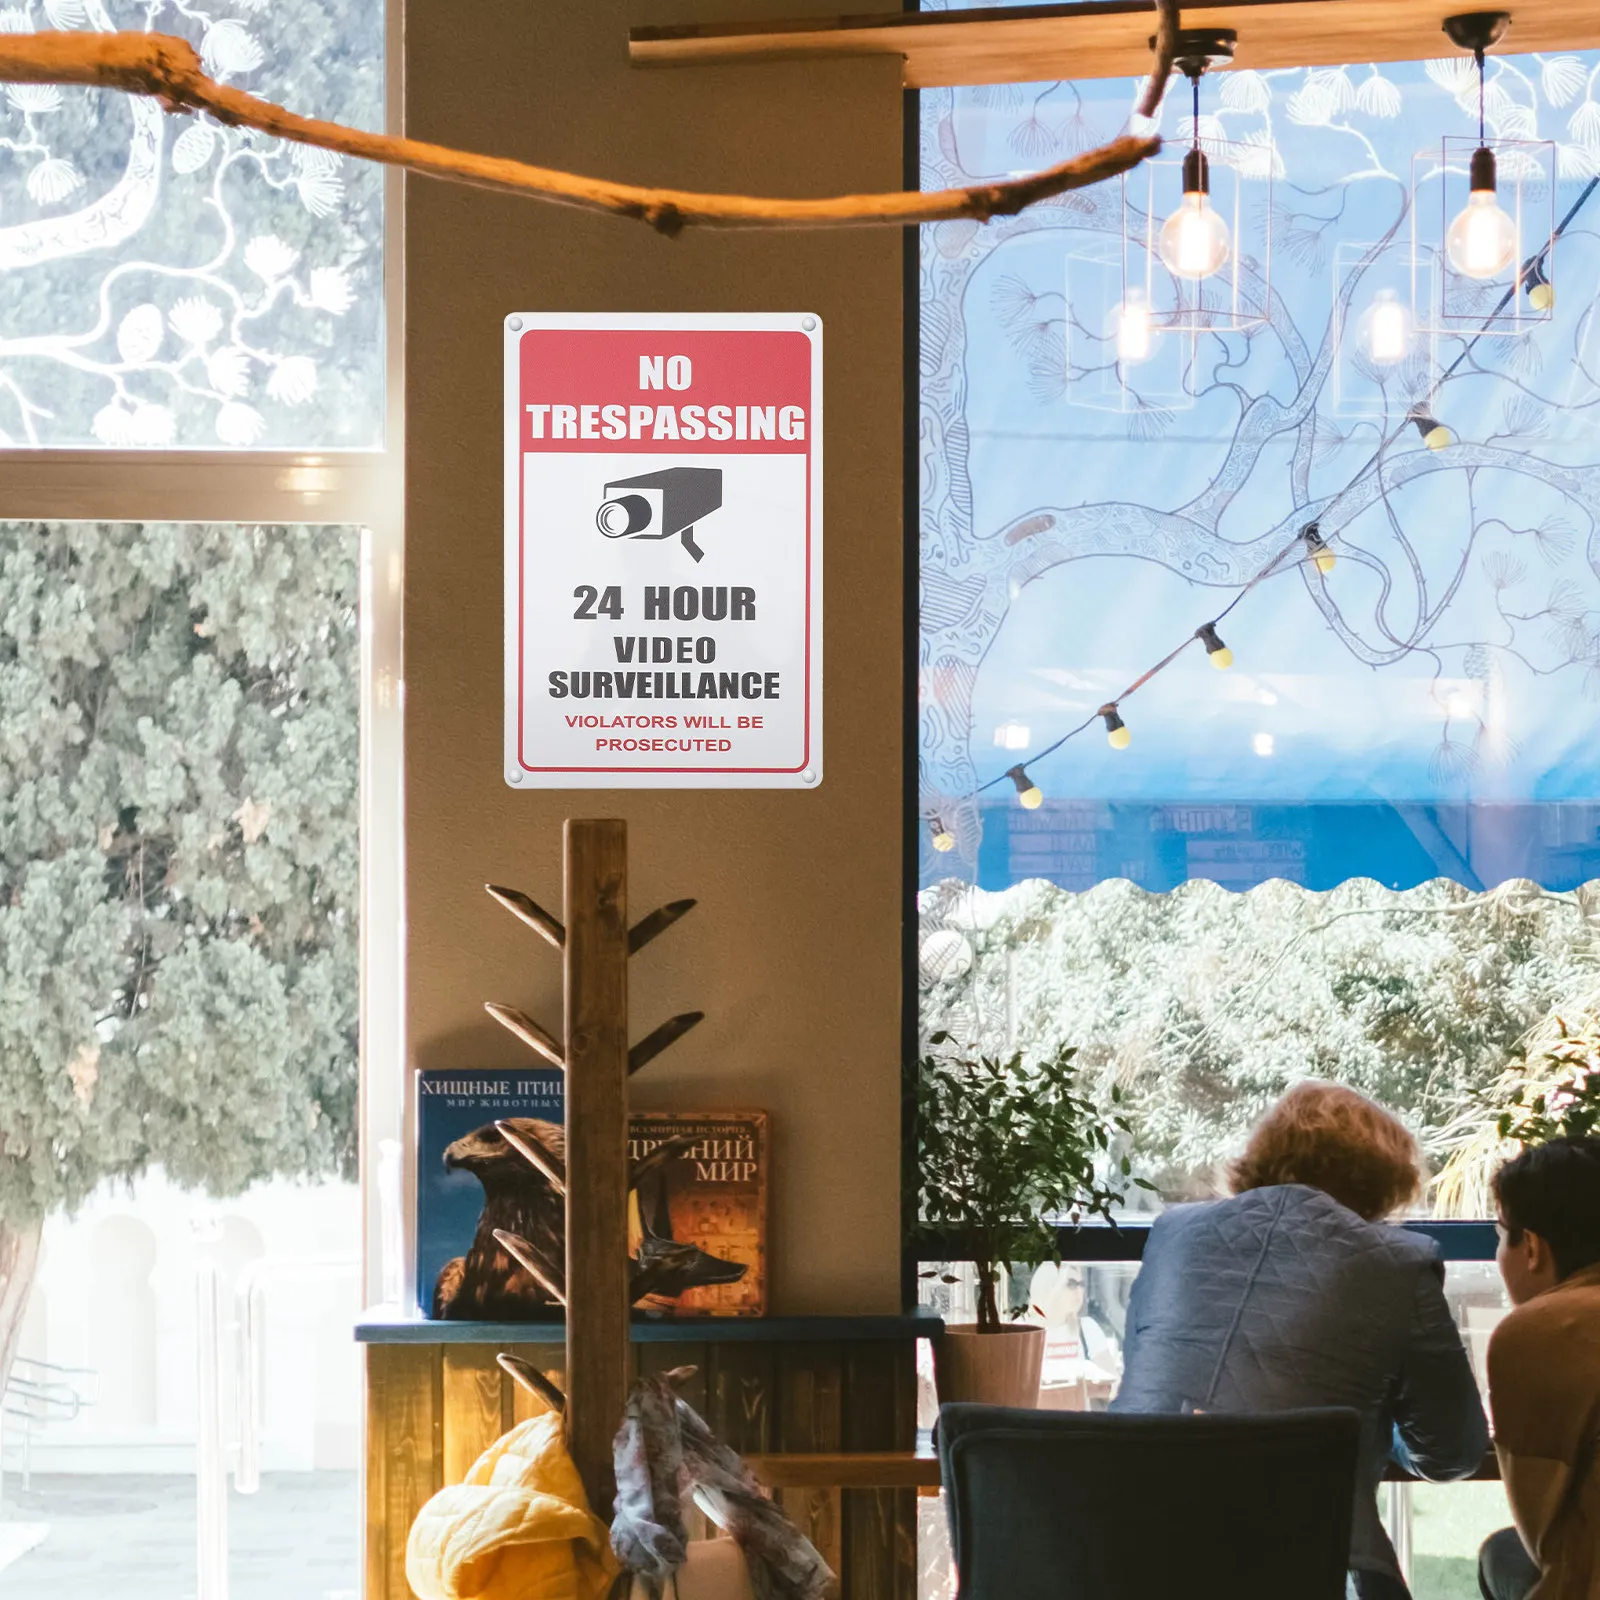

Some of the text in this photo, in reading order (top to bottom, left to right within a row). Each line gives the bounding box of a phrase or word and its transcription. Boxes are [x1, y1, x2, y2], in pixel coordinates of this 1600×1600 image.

[639, 355, 692, 391] NO
[526, 404, 805, 441] TRESPASSING
[573, 585, 756, 621] 24 HOUR
[613, 636, 716, 664] VIDEO
[548, 671, 780, 699] SURVEILLANCE
[564, 715, 764, 729] VIOLATORS WILL BE
[595, 738, 732, 752] PROSECUTED
[422, 1080, 511, 1097] ХИЩНЫЕ
[446, 1098, 560, 1108] МИР ЖИВОТНЫХ
[695, 1161, 757, 1182] МИР
